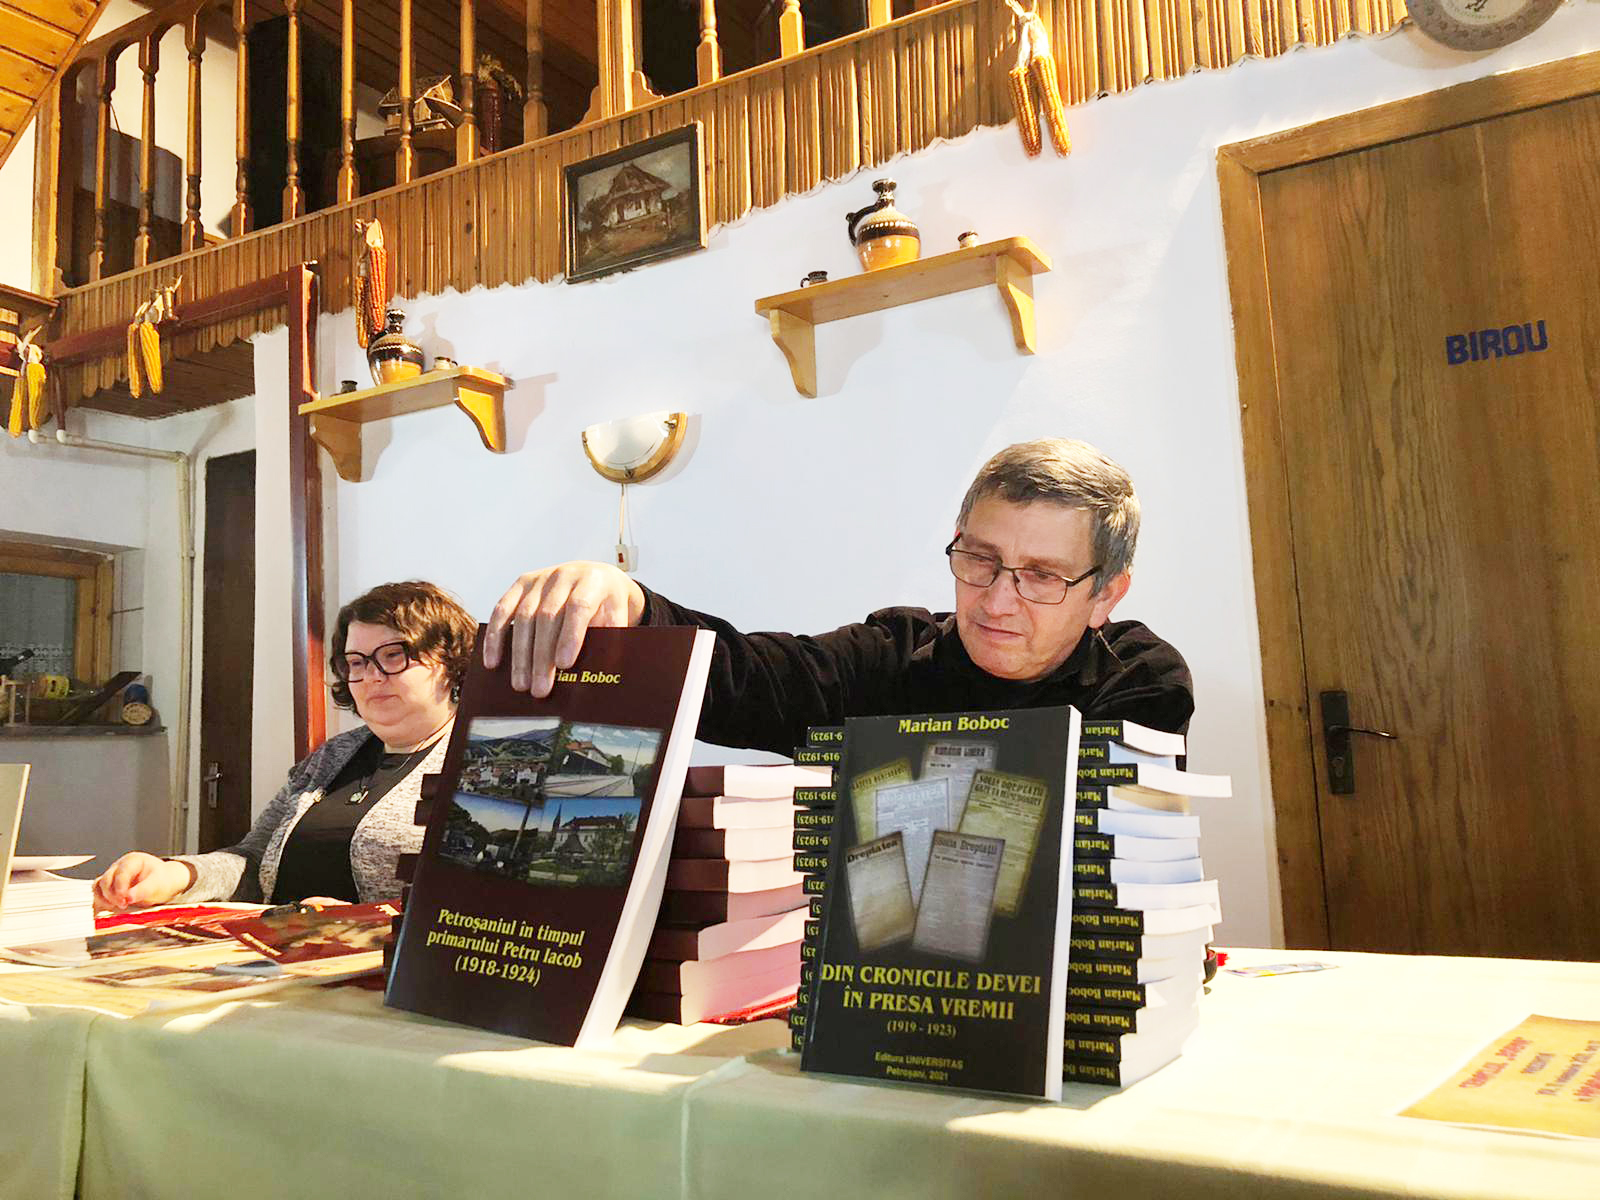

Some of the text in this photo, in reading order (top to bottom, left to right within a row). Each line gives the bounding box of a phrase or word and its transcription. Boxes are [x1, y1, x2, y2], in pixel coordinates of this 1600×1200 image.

[1446, 320, 1548, 365] BIROU
[580, 671, 621, 684] Boboc
[898, 715, 1010, 733] Marian Boboc
[1085, 726, 1119, 736] Marian
[1100, 768, 1134, 778] Marian
[1075, 840, 1110, 850] Marian
[1079, 888, 1113, 900] Marian
[437, 908, 585, 947] Petroșaniul în timpul
[1103, 915, 1139, 927] Marian
[426, 930, 583, 969] primarului Petru Iacob
[1099, 939, 1135, 952] Marian
[455, 955, 541, 988] (1918-1924)
[1096, 964, 1132, 976] Marian
[821, 964, 854, 982] DIN
[860, 966, 969, 990] CRONICILE
[976, 972, 1041, 994] DEVEI
[1104, 988, 1141, 1001] Marian
[843, 985, 1014, 1020] ÎN PRESA VREMII
[1094, 1015, 1130, 1028] Marian
[887, 1020, 917, 1033] (1919
[927, 1022, 957, 1038] 1923)
[1079, 1041, 1114, 1053] Marian
[875, 1052, 964, 1069] Editura UNIVERSITAS
[929, 1069, 948, 1081] 2021
